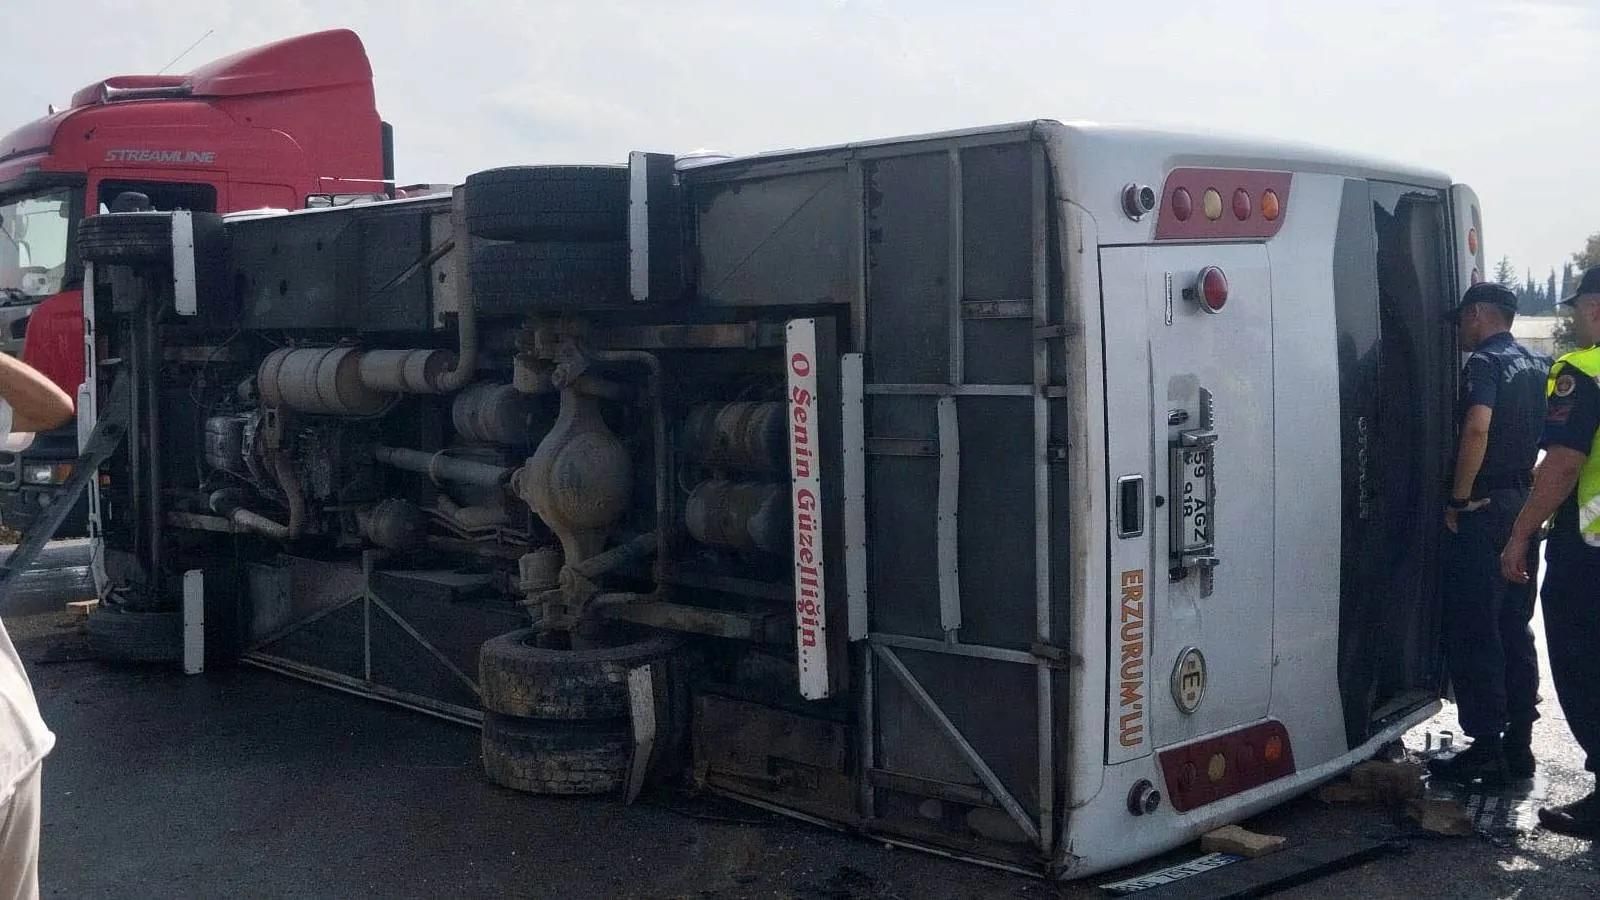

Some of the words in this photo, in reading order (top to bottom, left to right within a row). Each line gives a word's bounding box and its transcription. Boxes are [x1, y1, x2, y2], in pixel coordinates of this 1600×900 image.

[104, 149, 217, 164] STREAMLINE
[790, 352, 811, 377] O
[792, 385, 814, 478] Senin
[1193, 452, 1206, 478] 59
[1183, 481, 1193, 518] 918
[1193, 498, 1206, 543] AGZ
[1120, 569, 1143, 747] ERZURUM'LU
